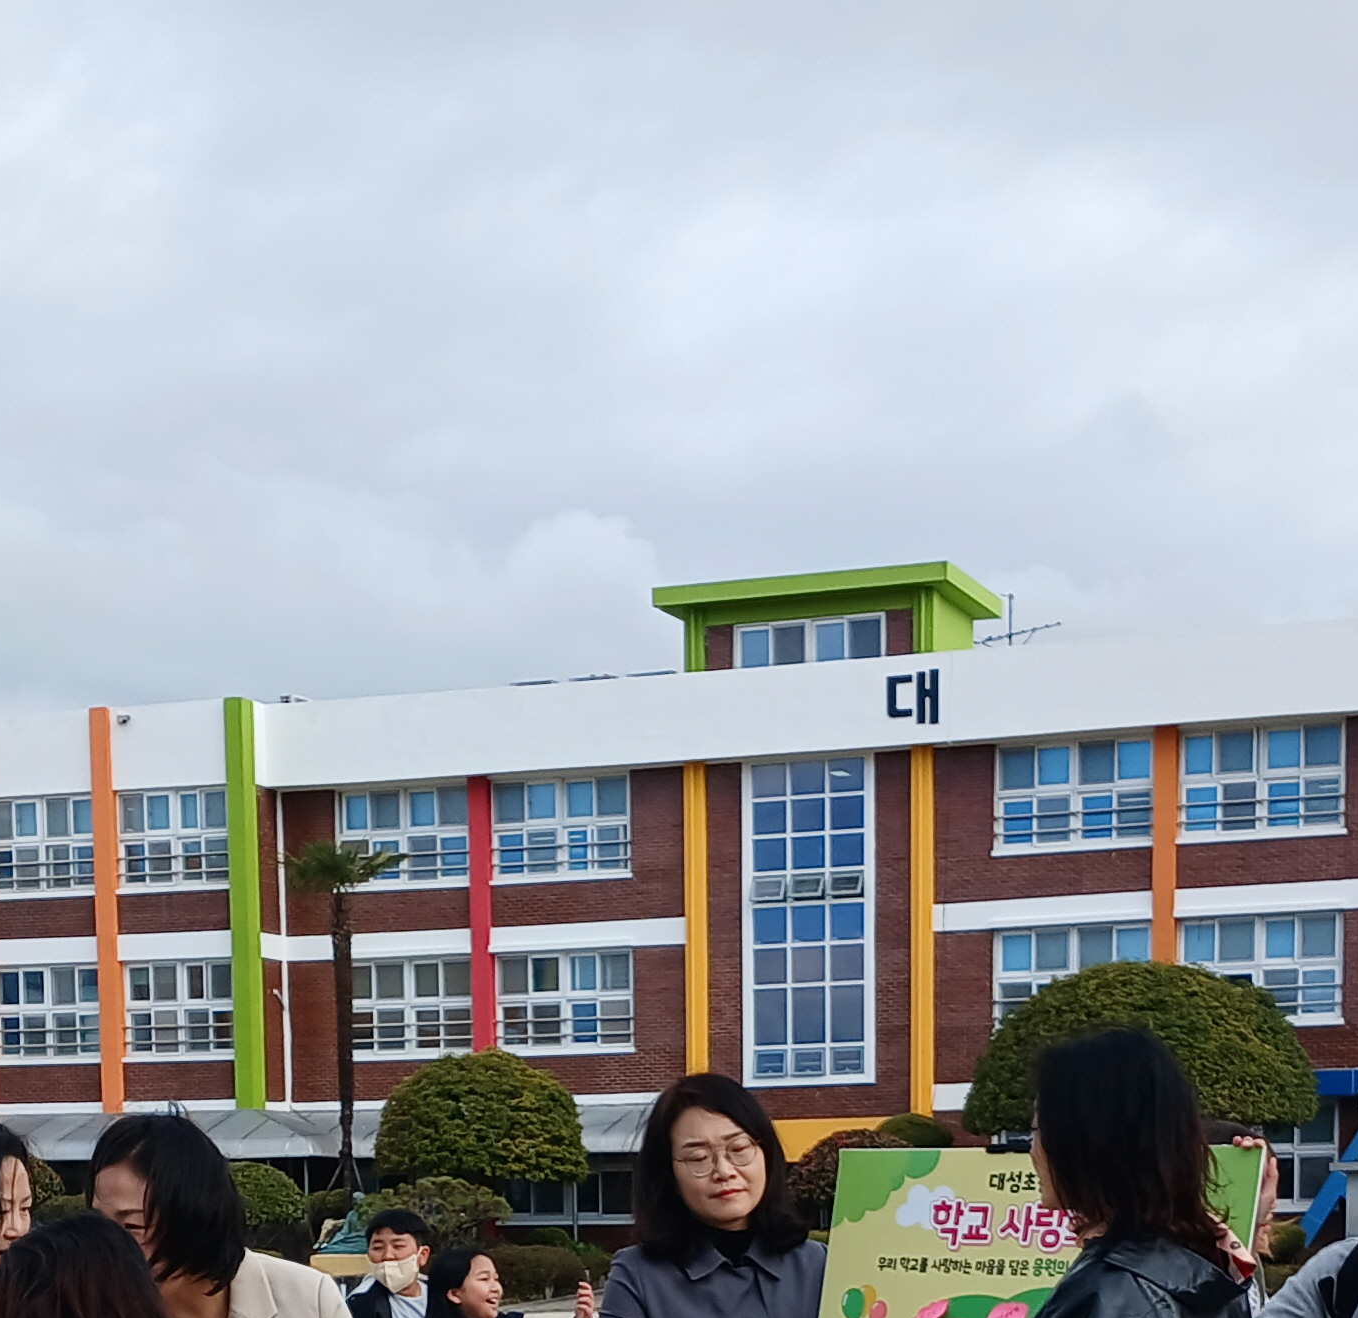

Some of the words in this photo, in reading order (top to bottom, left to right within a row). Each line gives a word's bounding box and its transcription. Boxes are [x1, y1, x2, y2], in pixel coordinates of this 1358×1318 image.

[885, 668, 940, 726] 대
[988, 1170, 1042, 1194] 대성초
[932, 1200, 990, 1247] 학교
[877, 1256, 897, 1272] 우리
[899, 1257, 928, 1273] 학교를
[930, 1257, 972, 1275] 사랑하는
[974, 1258, 1007, 1275] 마음을
[1008, 1260, 1030, 1276] 담은
